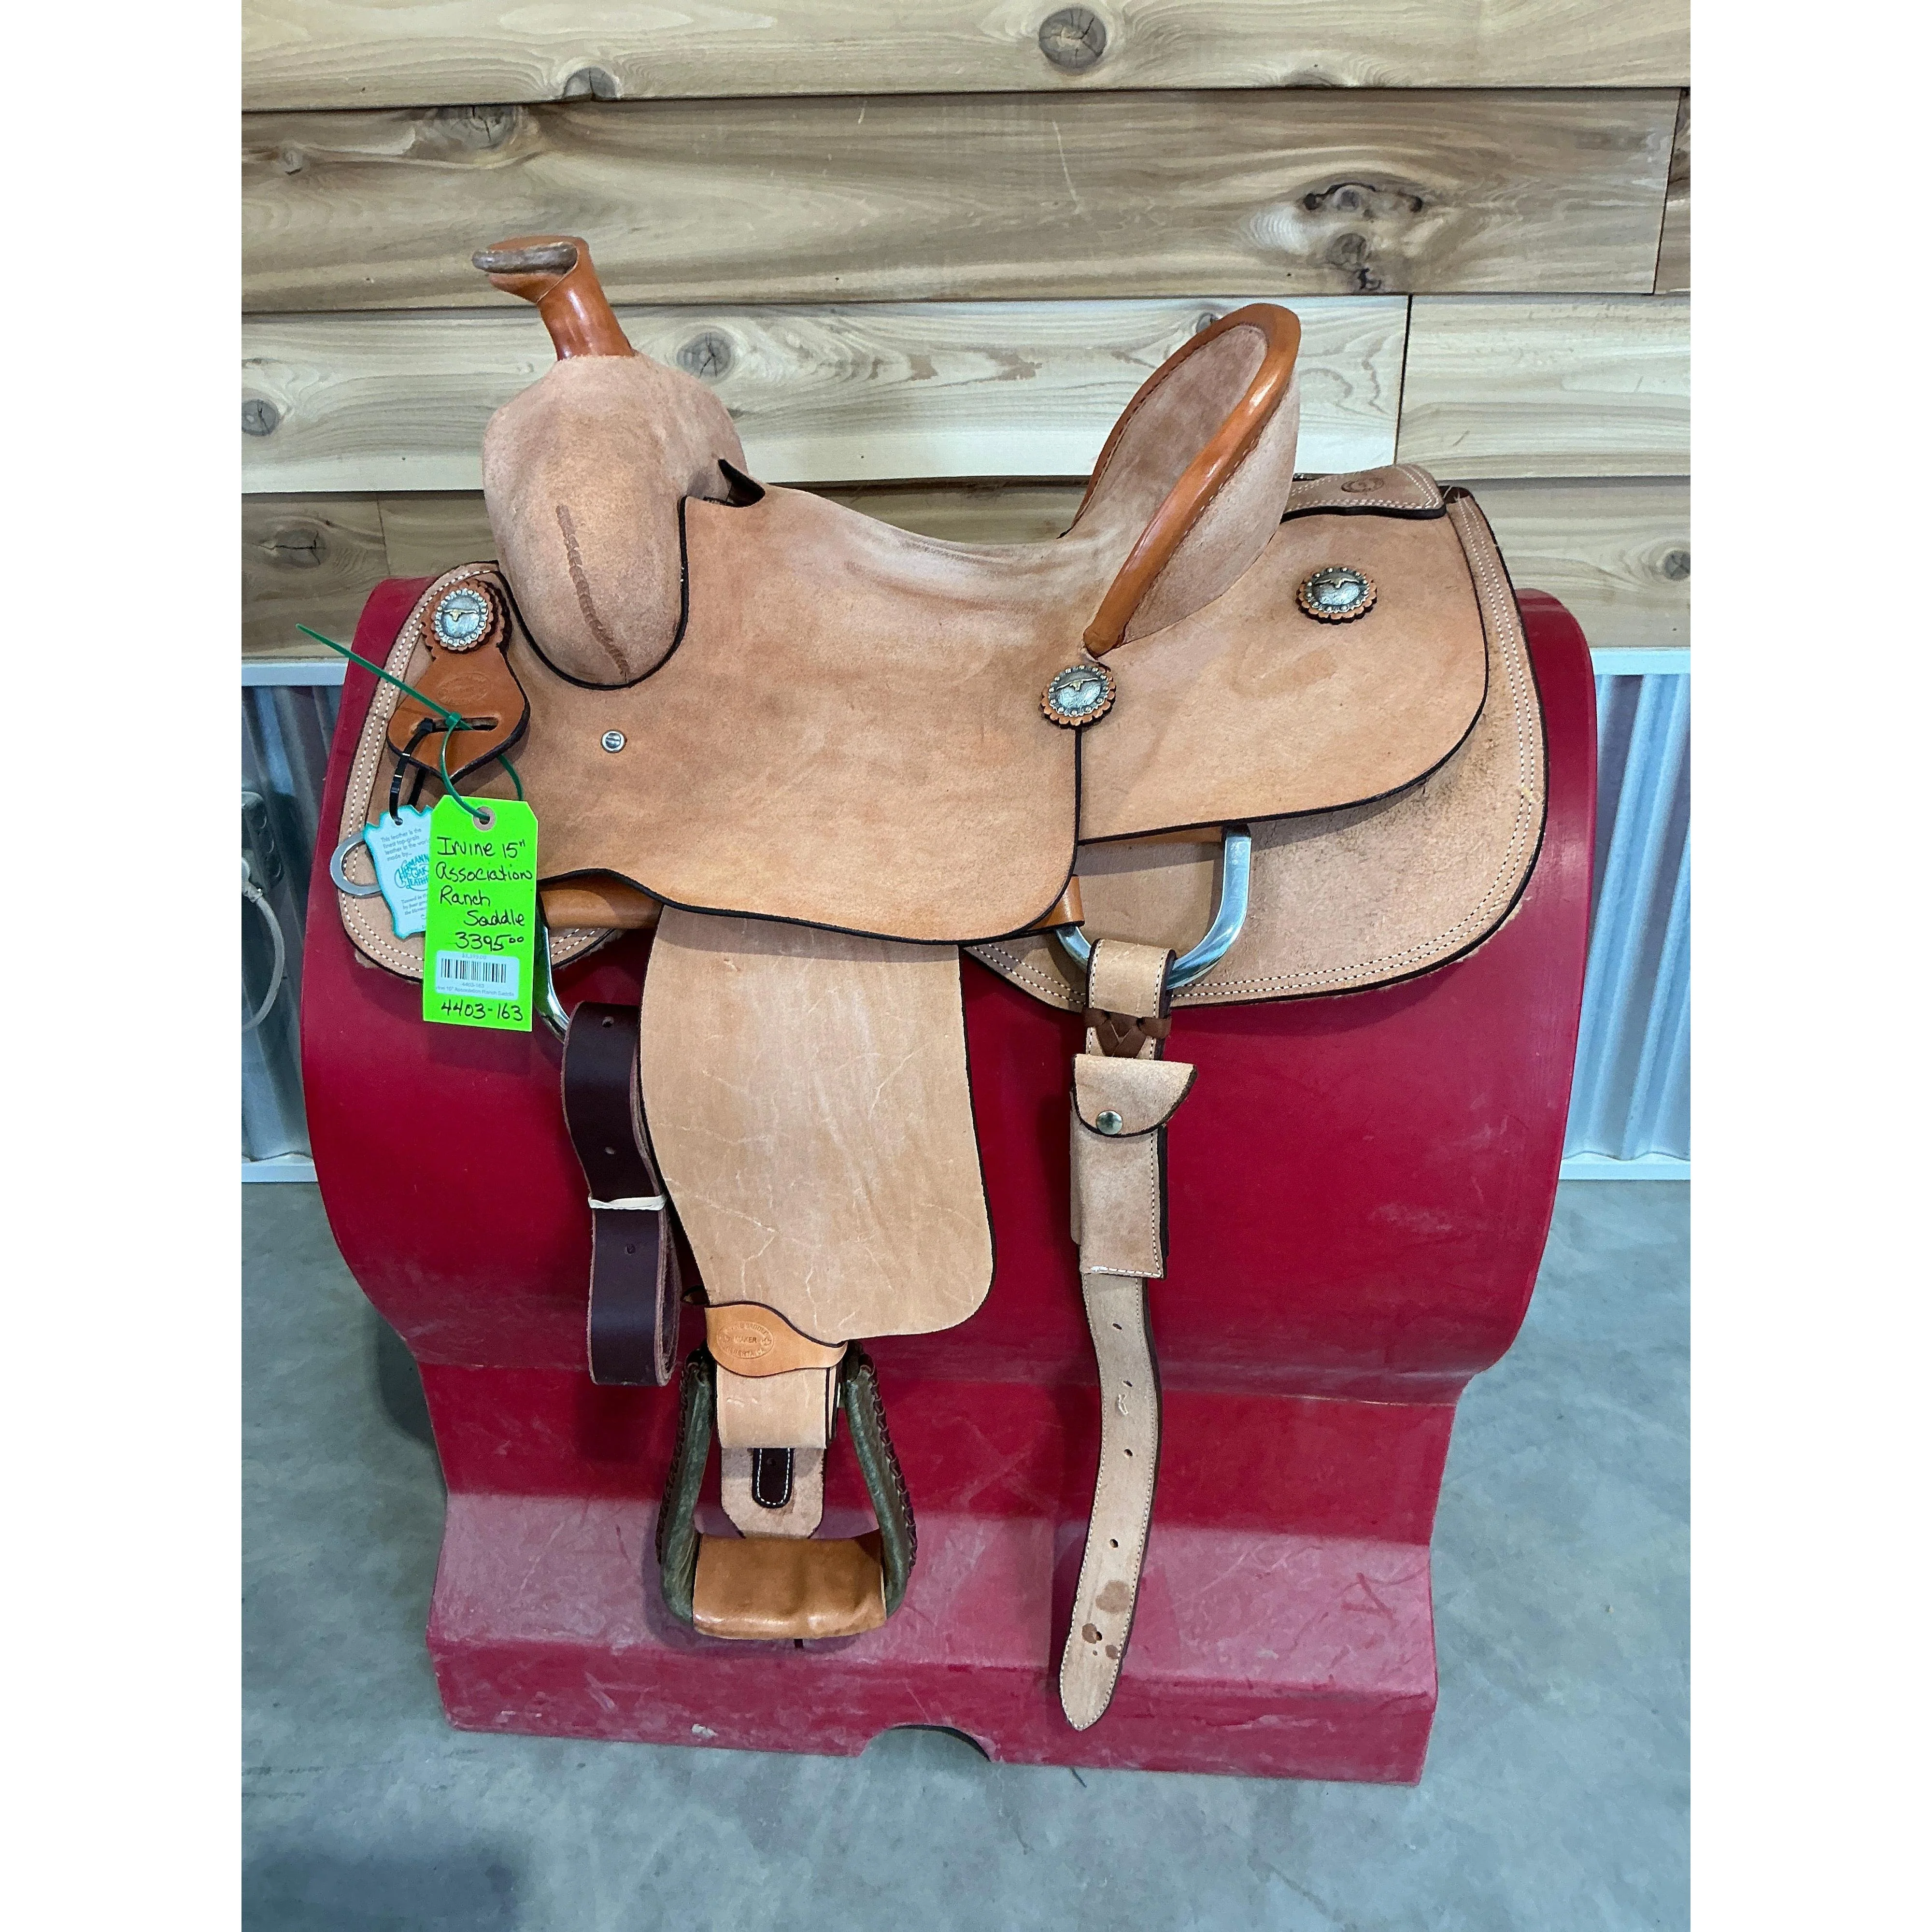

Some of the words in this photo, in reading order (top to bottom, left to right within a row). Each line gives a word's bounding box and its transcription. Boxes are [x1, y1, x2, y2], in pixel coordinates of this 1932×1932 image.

[437, 836, 495, 856] Irvine
[502, 839, 526, 858] 15"
[436, 861, 533, 883] Association
[440, 885, 490, 907] Ranch
[464, 909, 525, 926] Saddle
